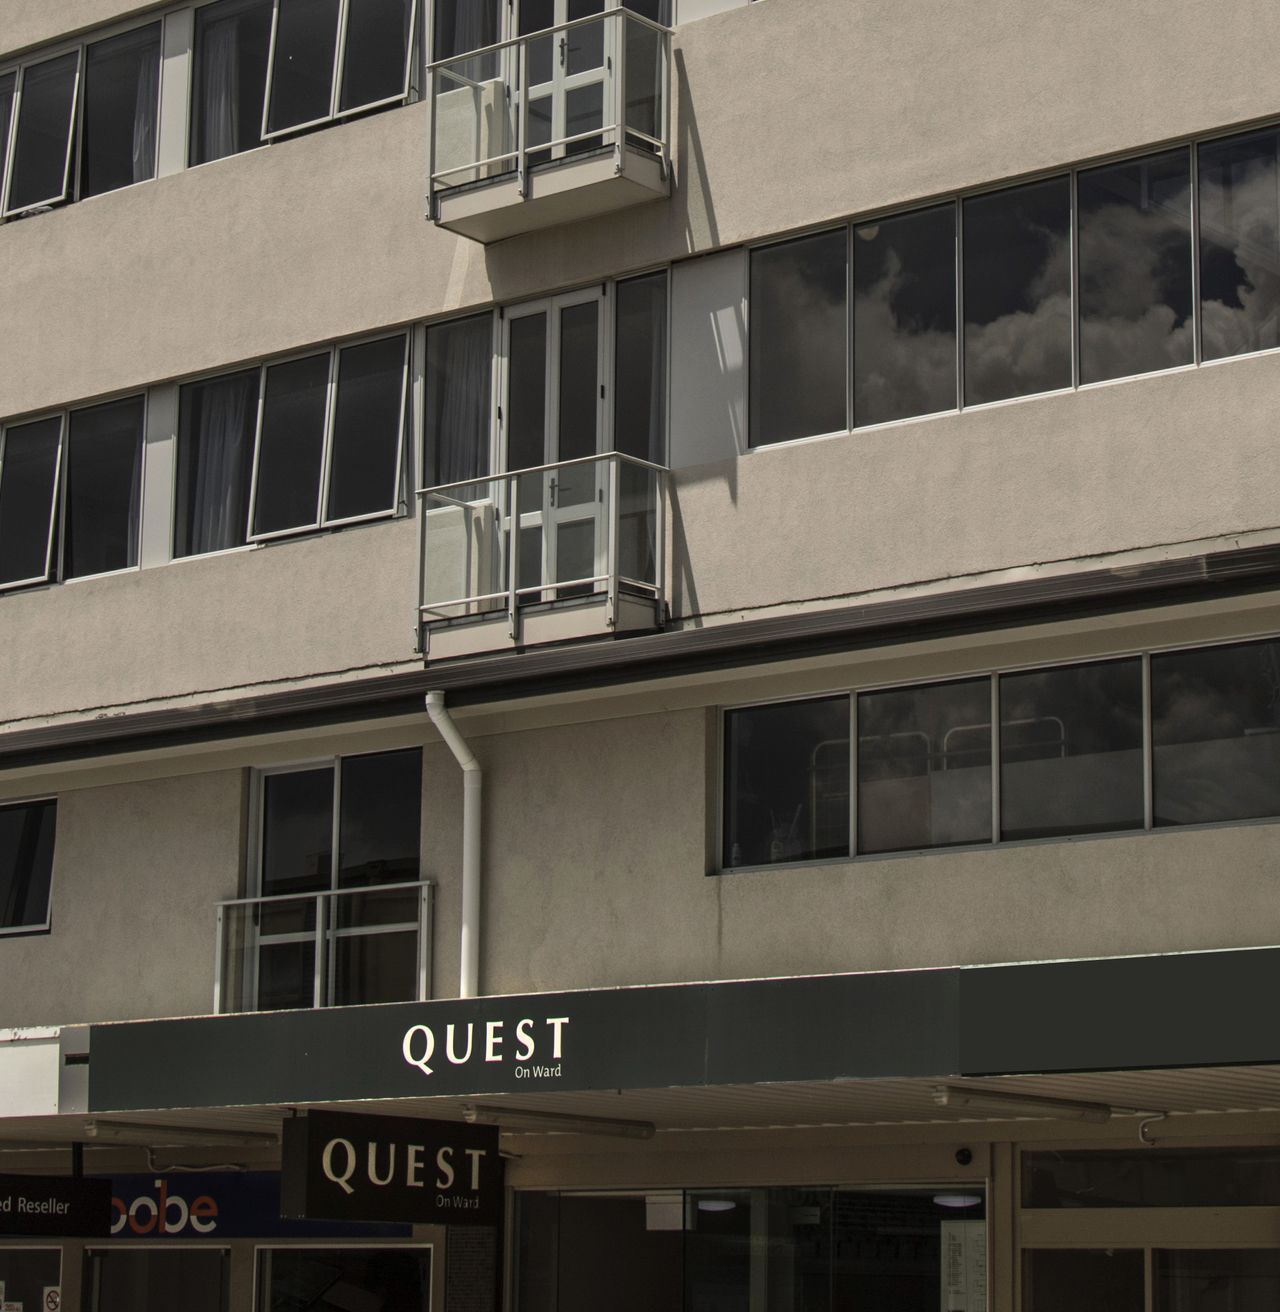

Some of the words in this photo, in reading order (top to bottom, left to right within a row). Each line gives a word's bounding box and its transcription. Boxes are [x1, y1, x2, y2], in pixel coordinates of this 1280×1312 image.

[402, 1016, 570, 1075] QUEST
[514, 1065, 530, 1079] On
[532, 1063, 562, 1078] Ward
[322, 1137, 487, 1195] QUEST
[18, 1197, 70, 1214] Reseller
[435, 1194, 451, 1209] On
[453, 1195, 480, 1209] Ward
